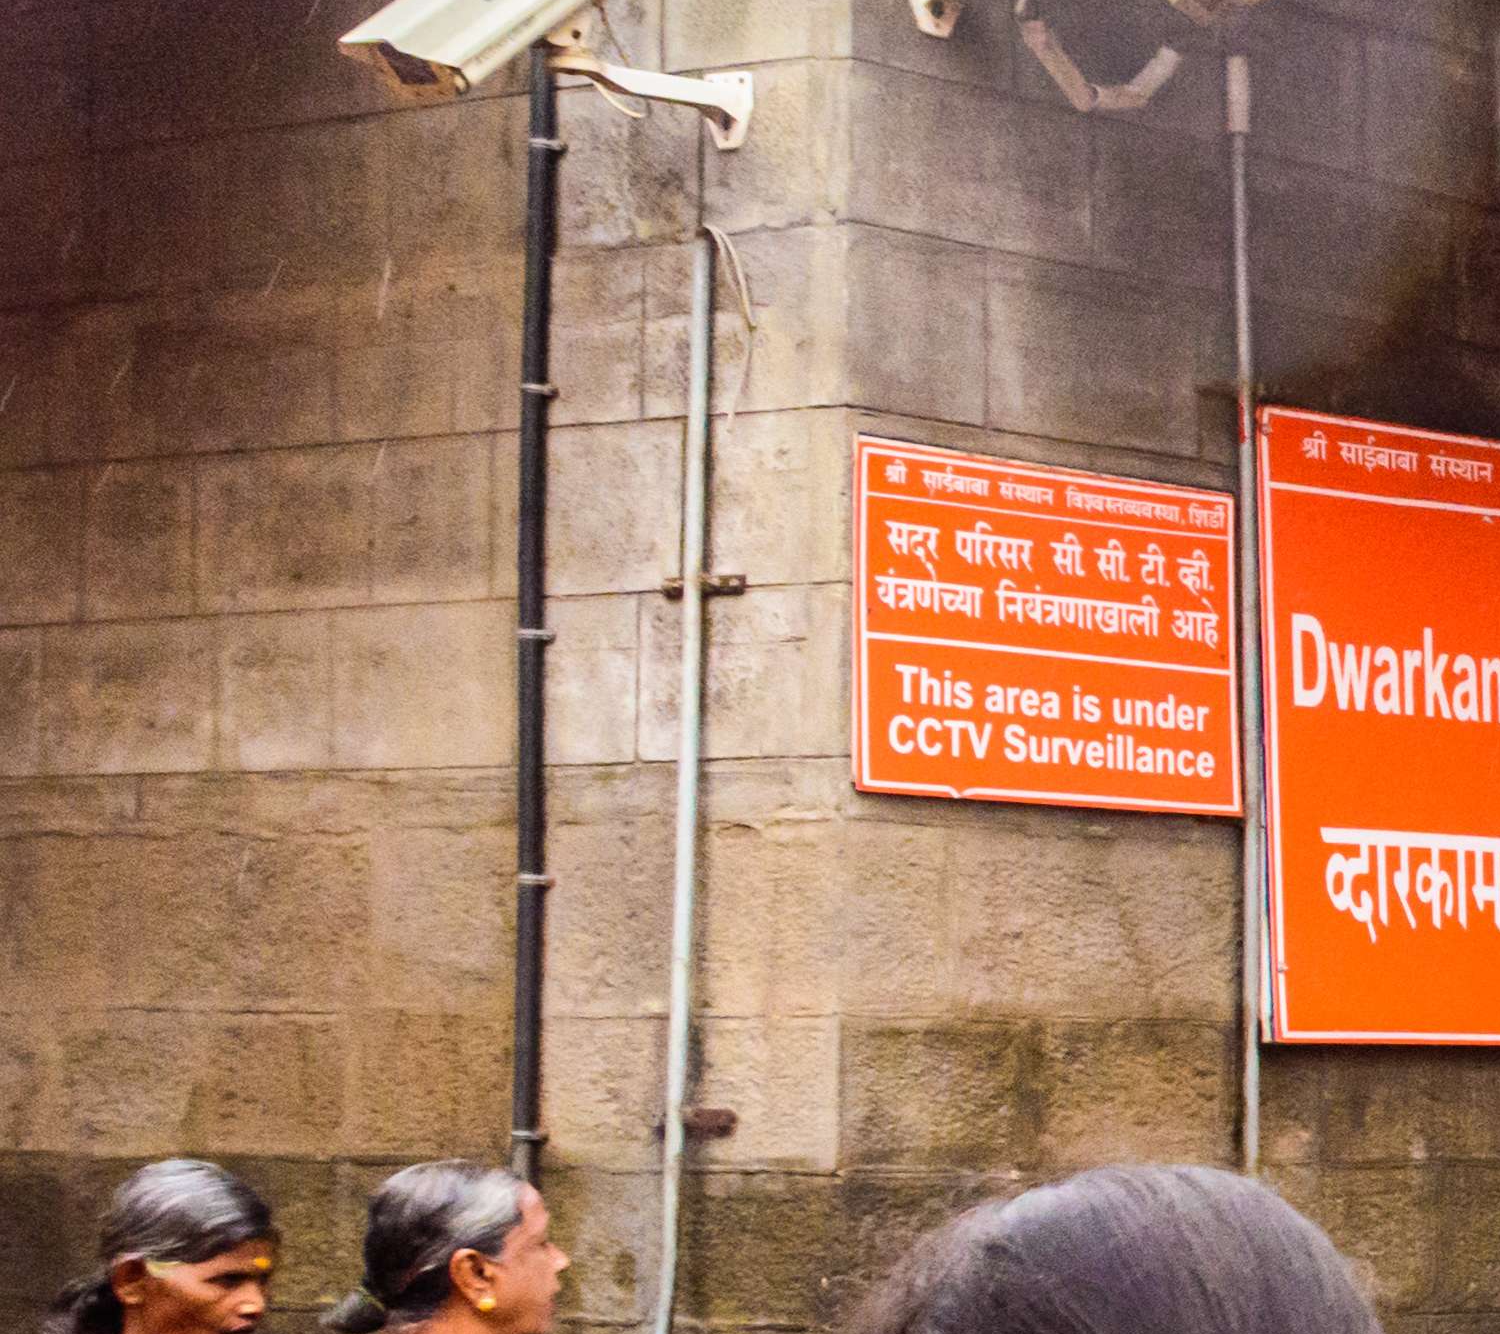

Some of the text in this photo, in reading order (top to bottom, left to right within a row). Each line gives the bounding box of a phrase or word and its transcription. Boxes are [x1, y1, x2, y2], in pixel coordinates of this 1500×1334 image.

[884, 459, 908, 485] श्री
[999, 476, 1054, 506] संस्थान
[1301, 430, 1328, 461] श्री
[1338, 435, 1419, 477] साईबाबा
[1430, 449, 1493, 484] संस्थान
[884, 519, 941, 563] सदर
[955, 521, 1033, 572] परिसर
[874, 559, 1220, 649] यंत्रणेच्या नियंत्रणाखाली आहे
[894, 663, 1209, 733] This area is under
[887, 715, 1216, 779] CCTV Surveillance
